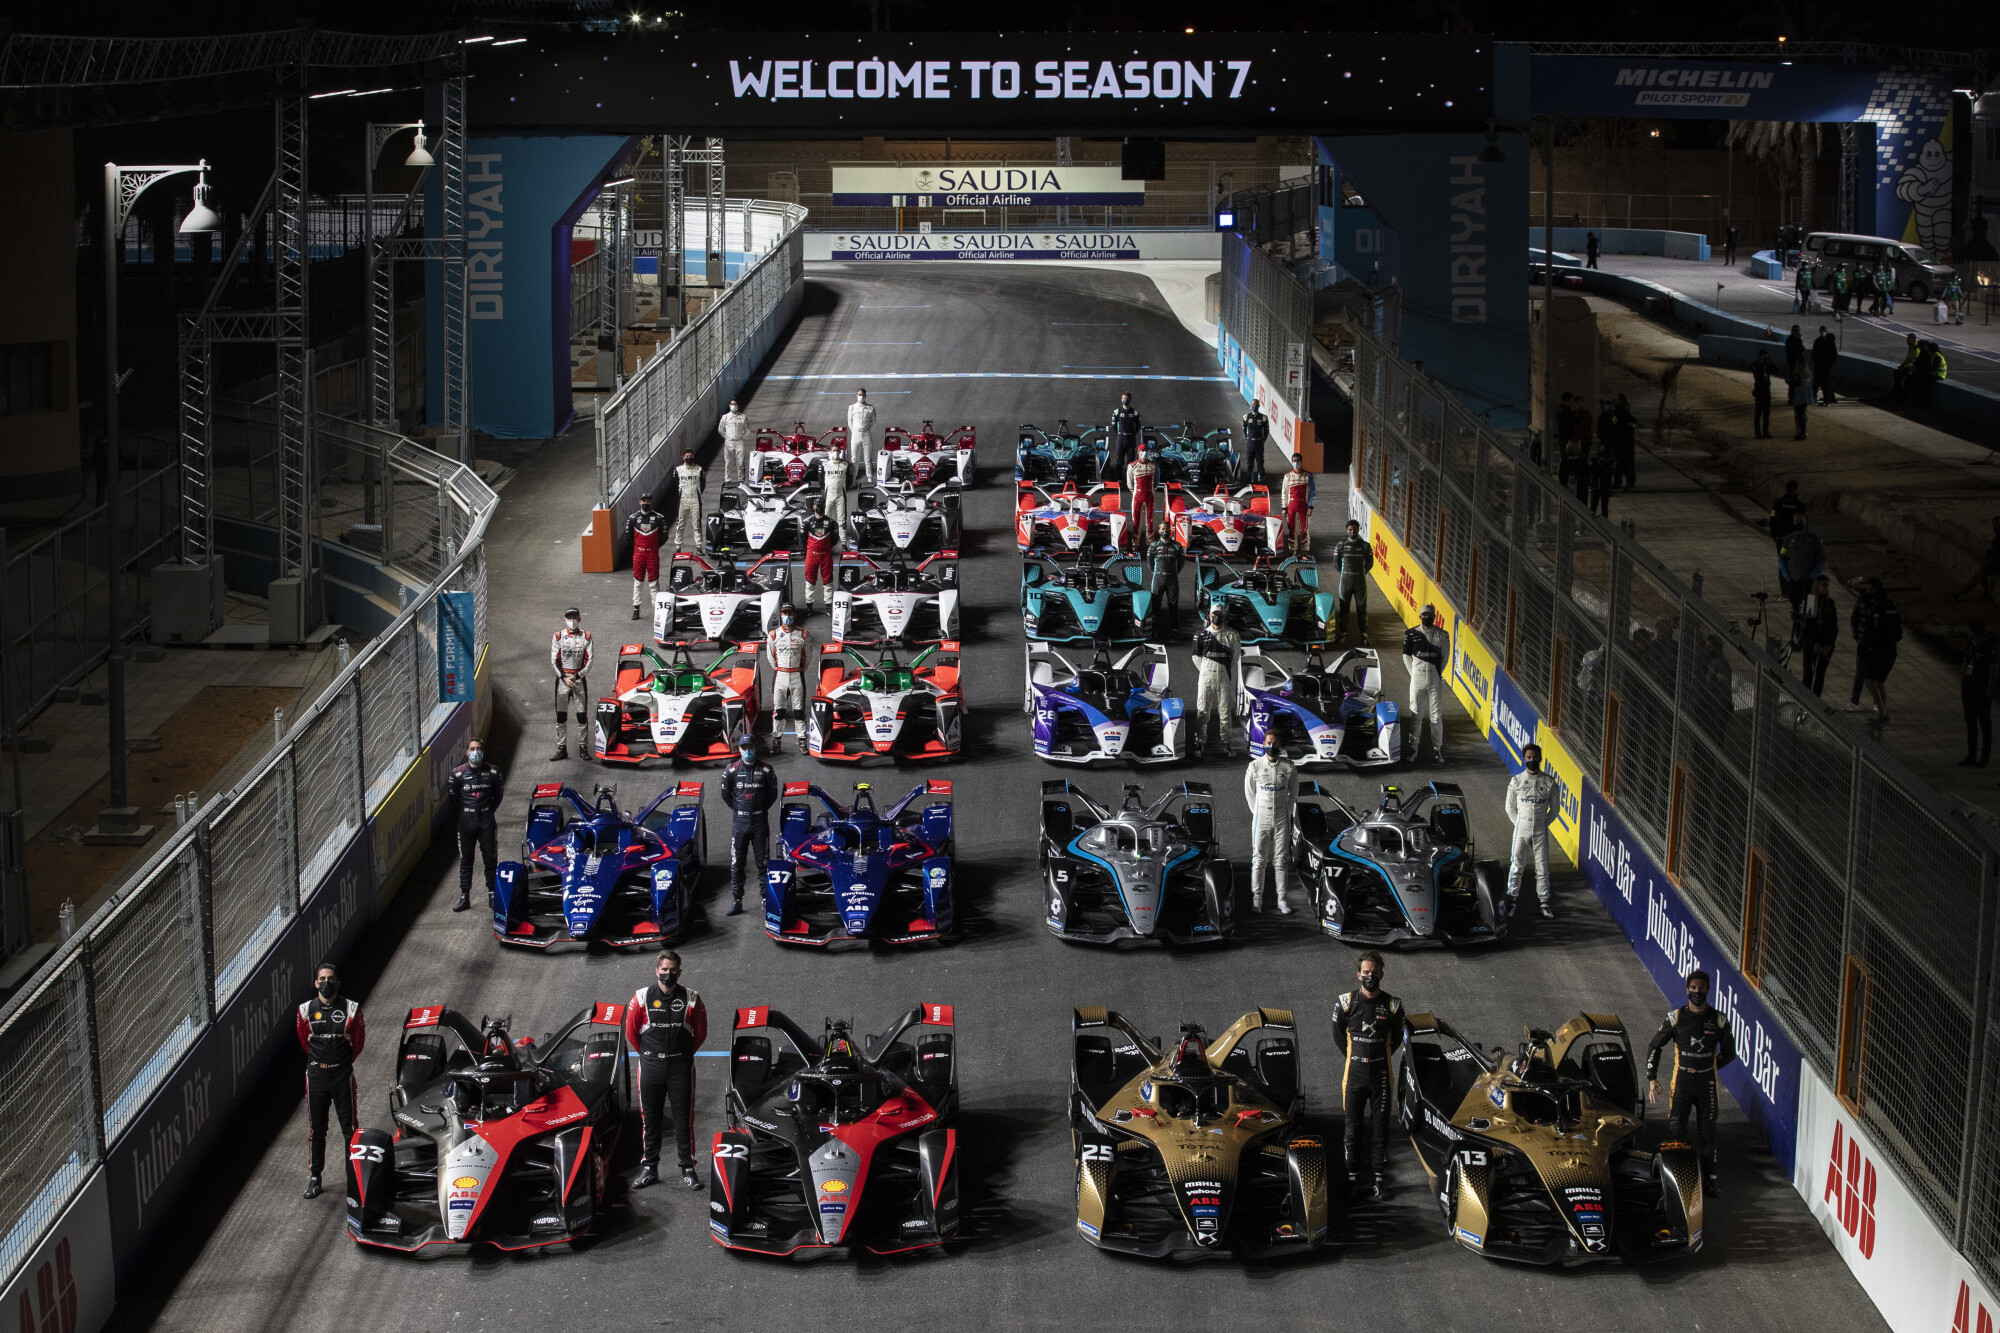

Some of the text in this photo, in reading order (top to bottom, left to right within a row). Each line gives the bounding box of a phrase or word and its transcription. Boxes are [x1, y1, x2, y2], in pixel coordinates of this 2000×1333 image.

[729, 60, 1253, 98] WELCOME TO SEASON 7
[1615, 68, 1774, 89] MICHELIN
[1641, 94, 1680, 103] PILOT
[1681, 94, 1724, 104] SPORT
[939, 169, 1062, 191] SAUDIA
[946, 194, 1031, 205] Official Airline
[467, 154, 503, 320] DIRIYAH
[850, 235, 931, 250] SAUDIA
[953, 235, 1035, 249] SAUDIA
[1055, 234, 1137, 249] SAUDIA
[1450, 156, 1487, 324] DIRIYAH
[854, 251, 911, 260] Official Airline
[958, 251, 1015, 259] Official Airline
[1060, 251, 1117, 259] Official Airline
[1289, 371, 1299, 384] F
[708, 516, 720, 525] 71
[1374, 532, 1389, 575] DHL
[1398, 565, 1417, 612] DHL
[1028, 592, 1041, 600] 10
[656, 601, 671, 611] 36
[834, 601, 849, 610] 99
[1462, 651, 1488, 702] MICHELIN
[446, 672, 455, 695] ABB
[598, 704, 615, 713] 33
[814, 703, 827, 712] 11
[1038, 710, 1056, 721] 28
[1253, 712, 1270, 723] 27
[1498, 699, 1531, 751] MICHELIN
[1588, 803, 1635, 905] Julius Bär
[500, 870, 514, 883] 4
[768, 870, 792, 884] 37
[1056, 870, 1068, 882] 5
[1325, 866, 1344, 877] 17
[841, 890, 875, 898] Envision
[847, 894, 868, 904] Virgin
[1645, 879, 1676, 965] Julius
[230, 958, 294, 1098] Julius Bär
[1715, 968, 1780, 1105] Julius Bär
[1114, 1045, 1136, 1054] Raku
[132, 1067, 211, 1233] Julius Bär
[715, 1143, 749, 1161] 22
[1082, 1144, 1114, 1161] 25
[1177, 1143, 1224, 1151] TOTAL
[349, 1144, 385, 1163] 23
[1460, 1150, 1488, 1166] 13
[1184, 1181, 1222, 1189] MAHLE
[1564, 1187, 1600, 1195] MAHLE
[1824, 1118, 1877, 1260] ABB
[449, 1191, 479, 1199] ABB
[1186, 1188, 1222, 1196] yahoo!
[1567, 1194, 1602, 1202] yahoo!
[1189, 1197, 1221, 1206] ABB
[1573, 1203, 1604, 1212] ABB
